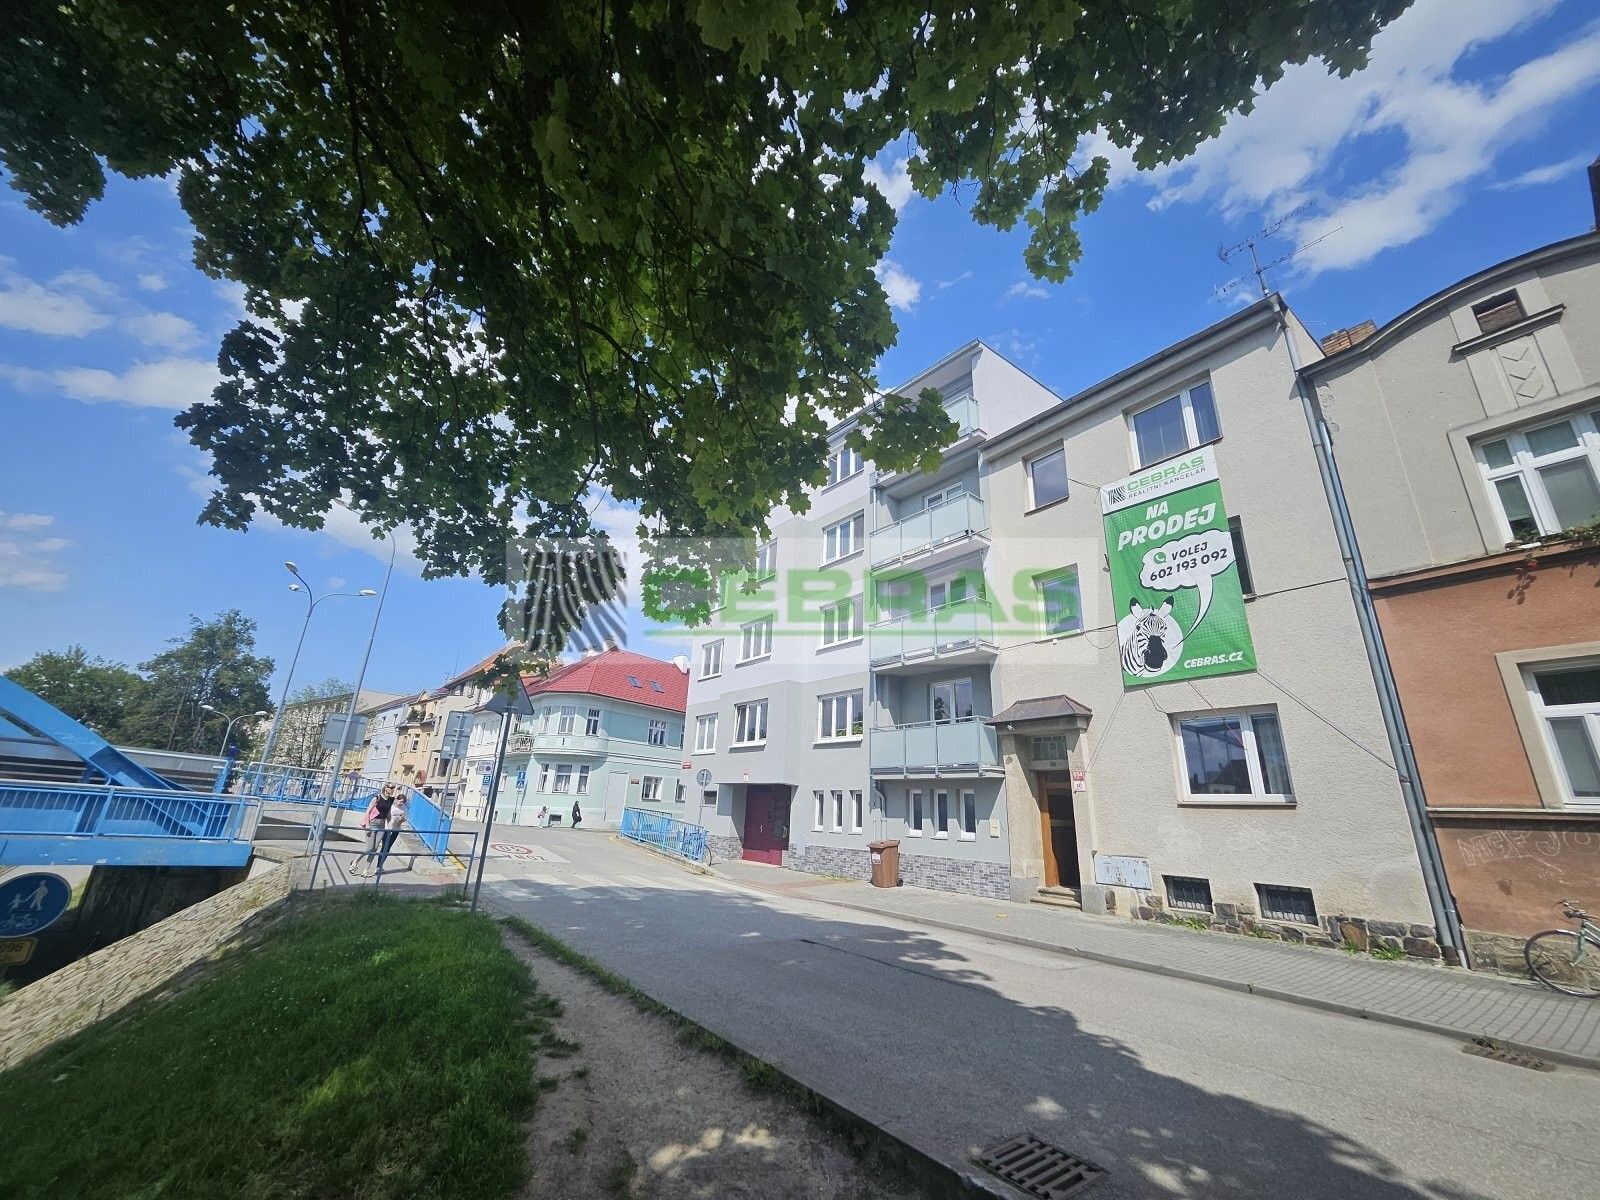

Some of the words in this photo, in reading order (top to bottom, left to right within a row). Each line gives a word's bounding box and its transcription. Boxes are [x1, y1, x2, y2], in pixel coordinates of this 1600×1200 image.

[1127, 455, 1204, 491] CEBRAS
[1146, 501, 1169, 520] NA
[1118, 503, 1216, 551] PRODEJ
[1171, 541, 1208, 561] VOLEJ
[1150, 567, 1173, 582] 602
[1176, 557, 1198, 573] 193
[1200, 548, 1228, 565] 092
[1184, 651, 1244, 669] CEBRAS.CZ
